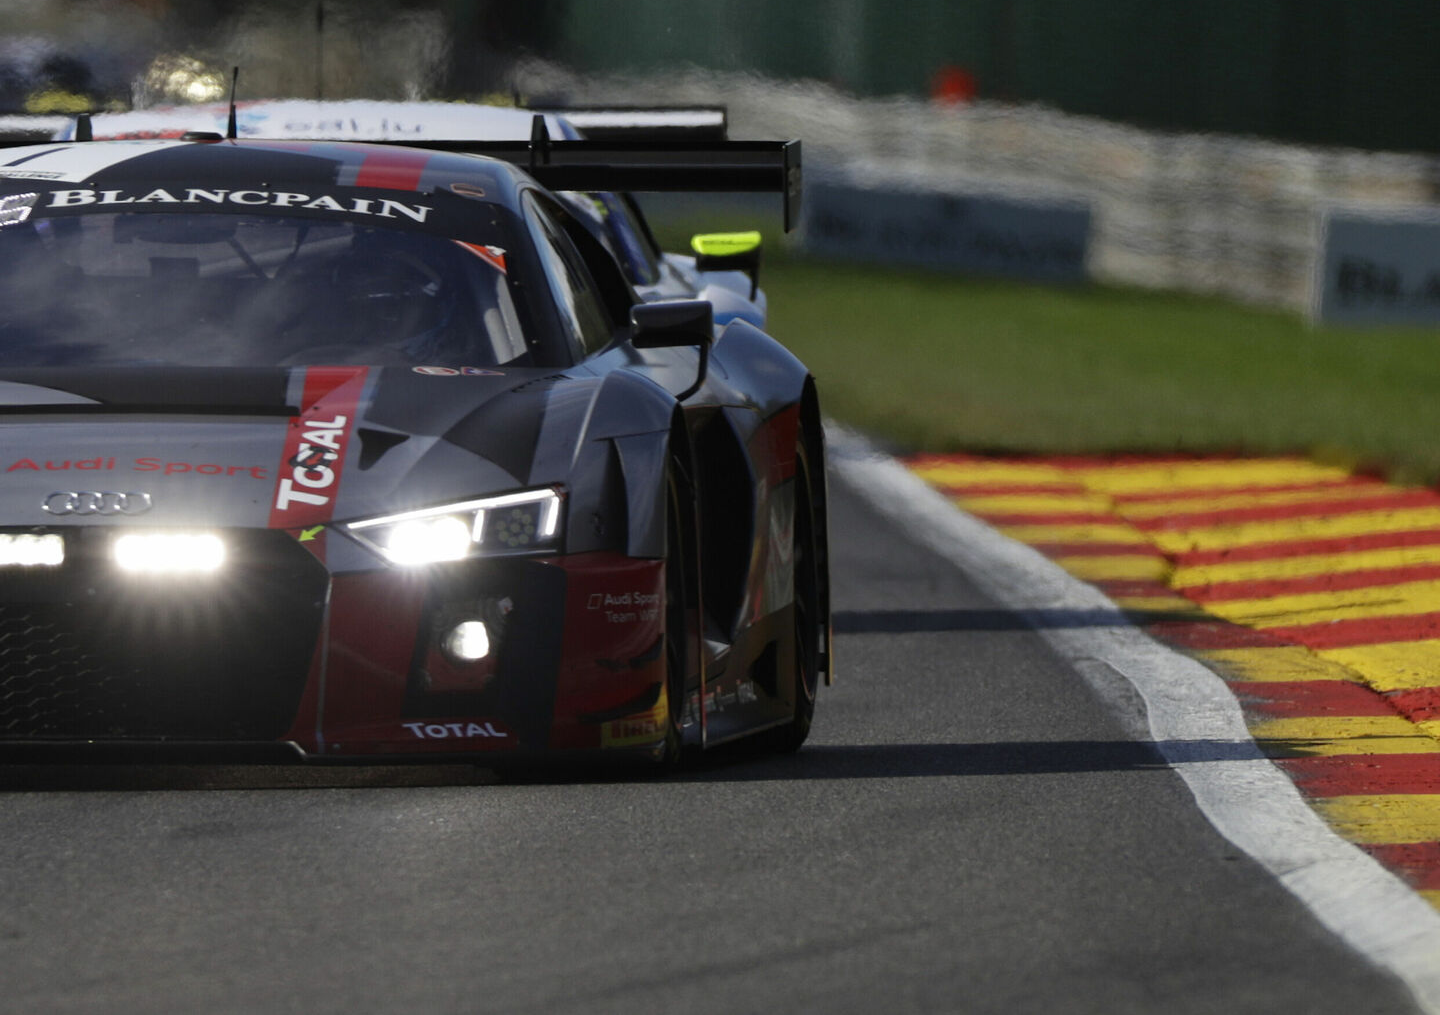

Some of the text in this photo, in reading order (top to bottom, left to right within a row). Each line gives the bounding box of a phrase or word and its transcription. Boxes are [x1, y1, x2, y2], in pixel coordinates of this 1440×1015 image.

[46, 187, 433, 224] BLANCPAIN
[6, 457, 269, 480] Audi Sport
[604, 592, 632, 606] Audi
[604, 610, 637, 624] Team
[401, 721, 509, 739] TOTAL
